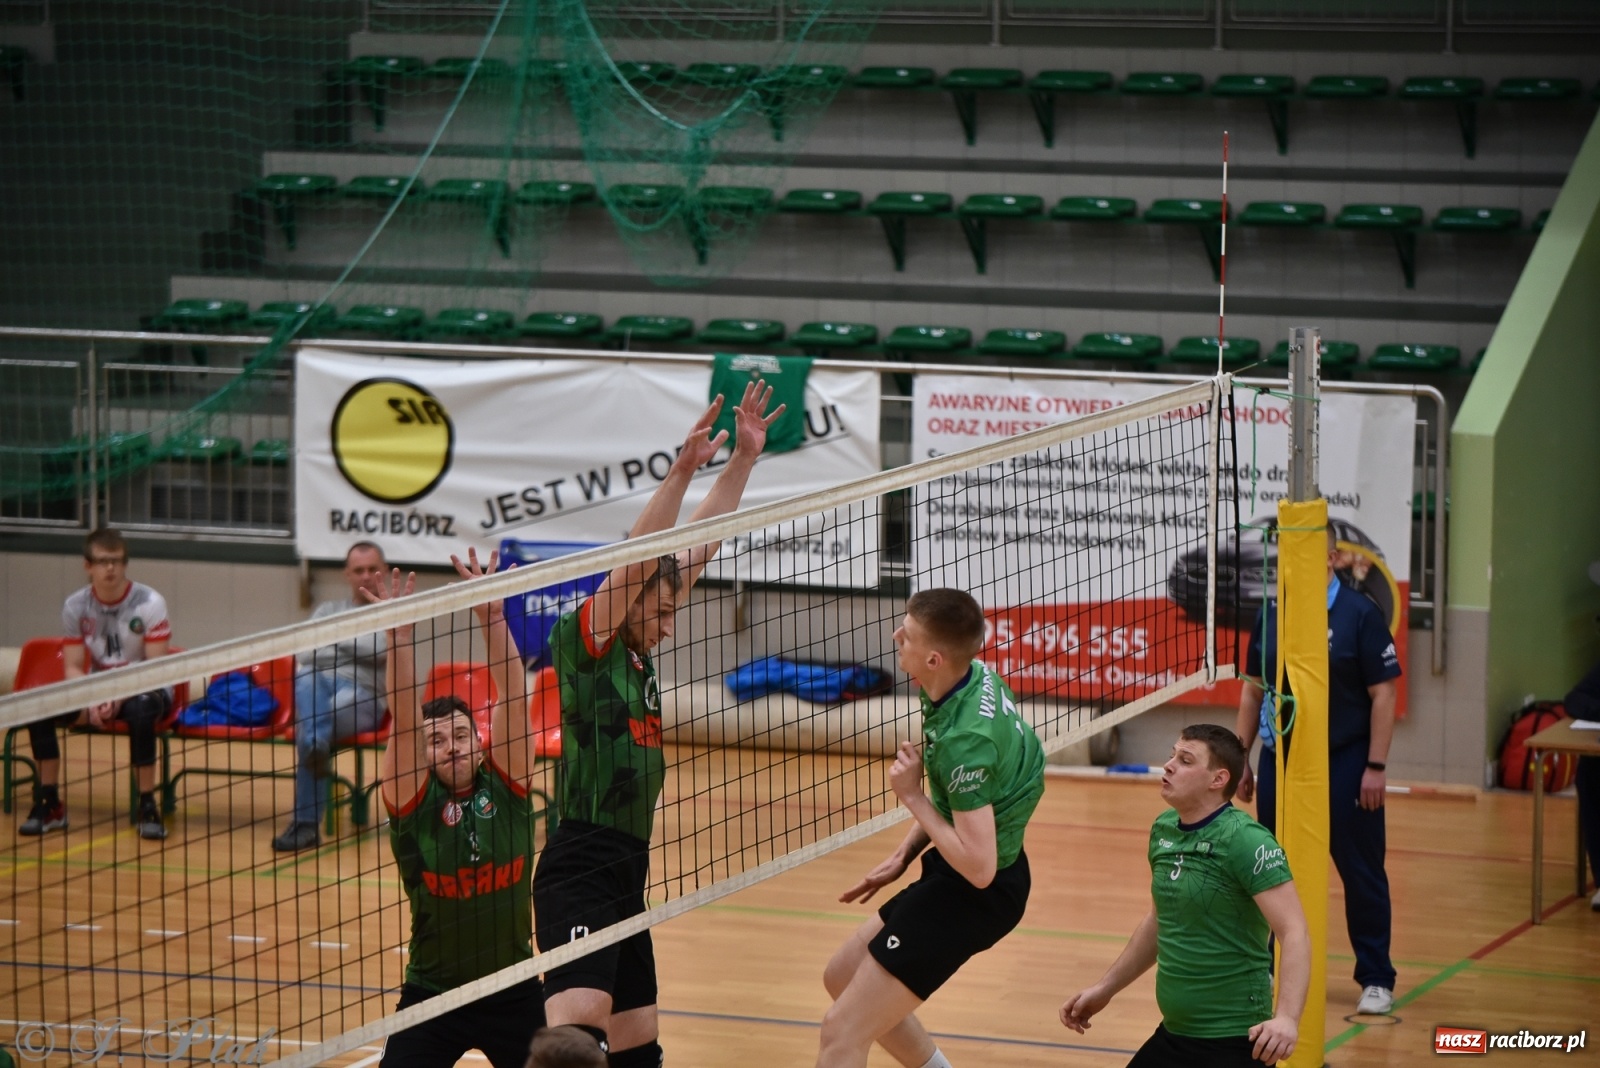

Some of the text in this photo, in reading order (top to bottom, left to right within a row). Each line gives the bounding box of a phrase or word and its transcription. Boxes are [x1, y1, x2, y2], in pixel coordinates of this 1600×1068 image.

[928, 393, 1032, 413] AWARYJNE
[928, 417, 981, 436] ORAZ
[480, 478, 566, 530] JEST
[576, 467, 610, 502] W
[330, 507, 457, 538] RACIBÓRZ
[1021, 620, 1081, 654] 496
[1087, 625, 1149, 659] 555
